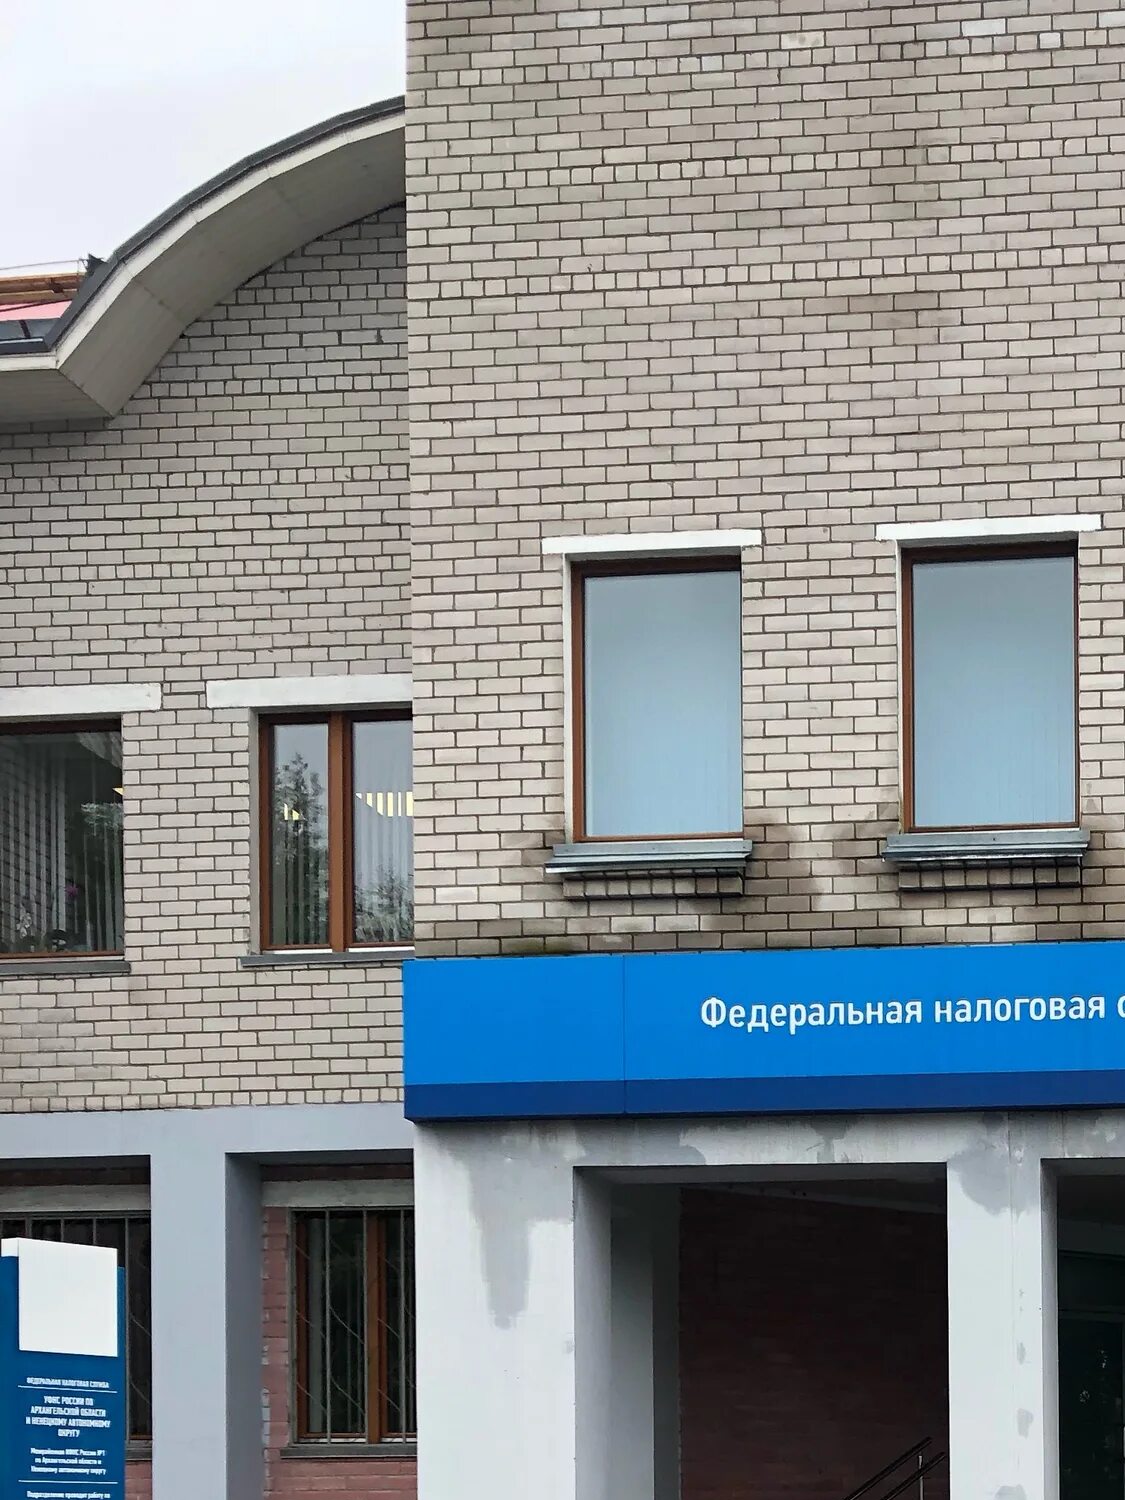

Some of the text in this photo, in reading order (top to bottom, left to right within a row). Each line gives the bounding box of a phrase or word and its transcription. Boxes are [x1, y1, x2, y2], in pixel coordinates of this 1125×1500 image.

[701, 996, 922, 1035] Федеральная
[934, 996, 1105, 1023] налоговая
[62, 1397, 84, 1405] РОССИИ
[31, 1406, 106, 1417] АРХАНГЕЛЬСКОЙ ОБЛАСТИ
[58, 1429, 80, 1437] ОКРУГУ
